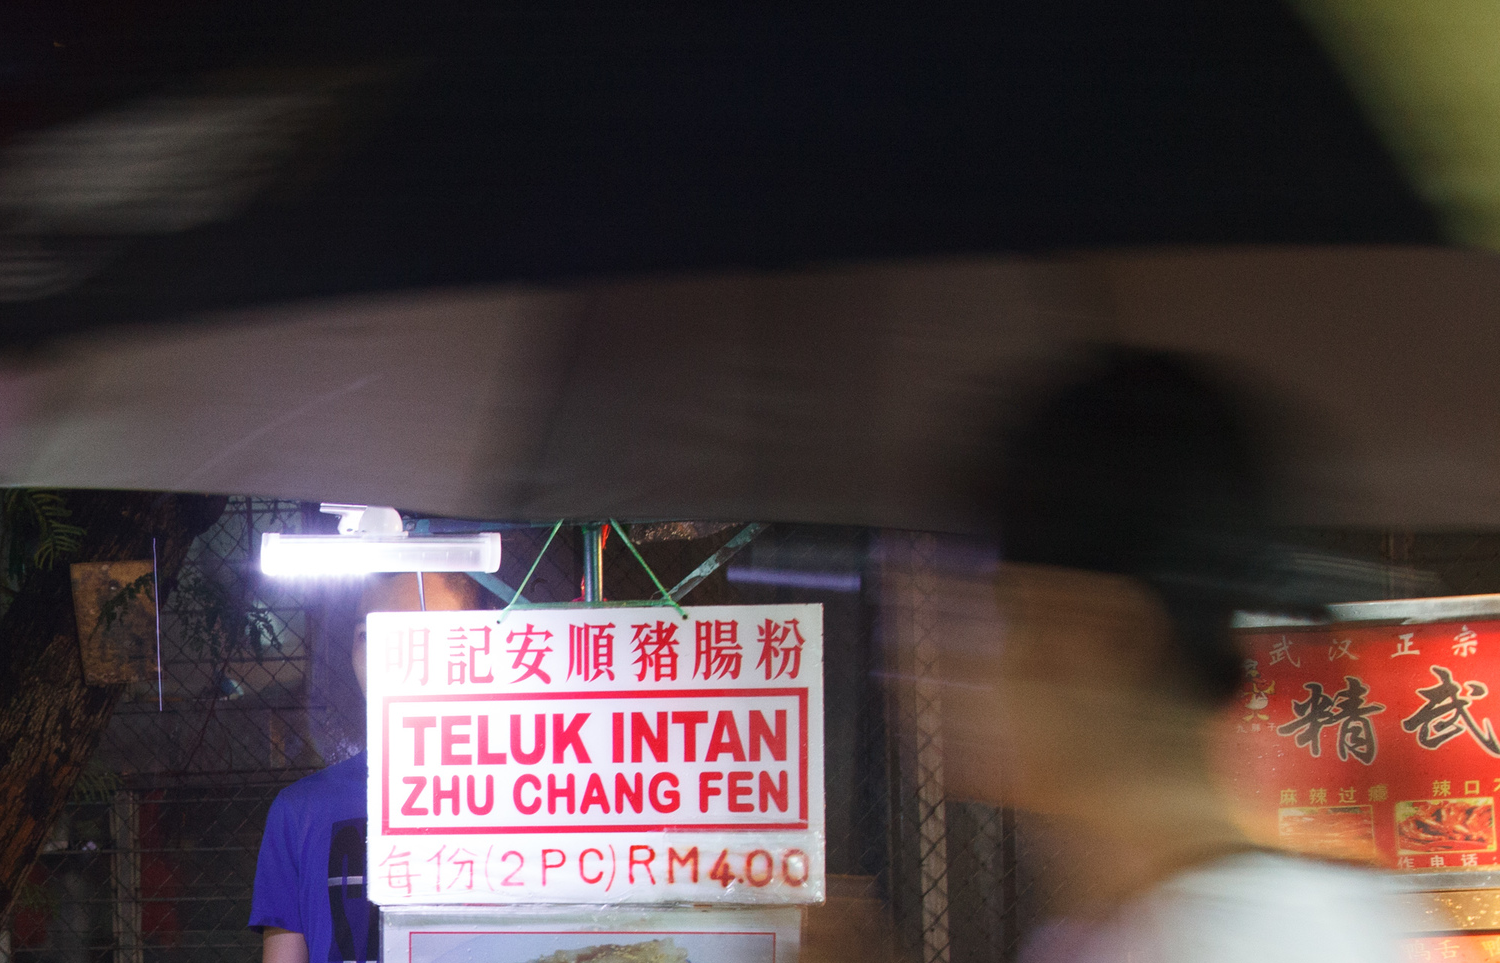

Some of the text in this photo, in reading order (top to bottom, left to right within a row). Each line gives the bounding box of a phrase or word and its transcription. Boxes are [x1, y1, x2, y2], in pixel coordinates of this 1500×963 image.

[385, 617, 806, 686] 明記安順豬腸粉
[402, 709, 788, 766] TELUK INTAN
[401, 771, 789, 817] ZHU CHANG FEN
